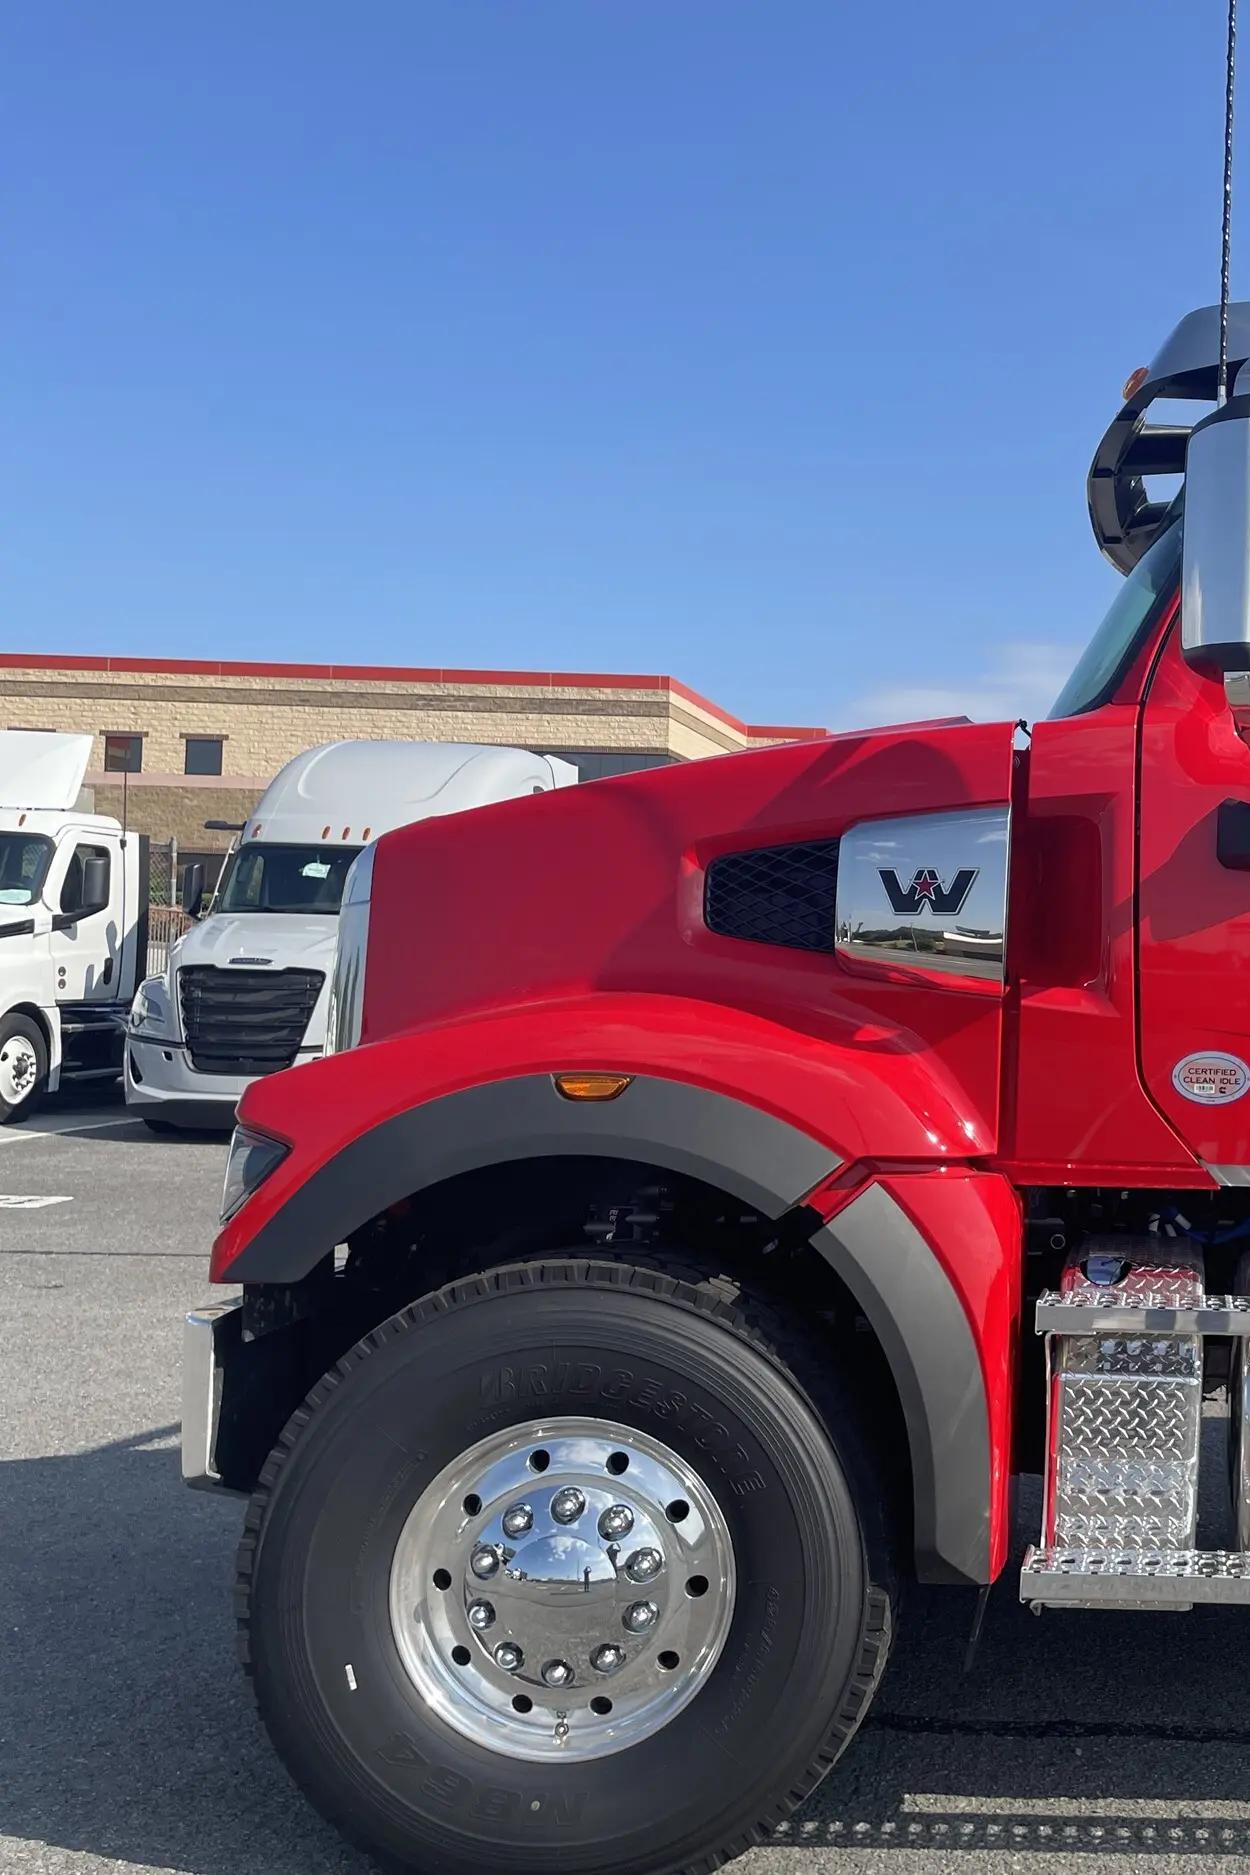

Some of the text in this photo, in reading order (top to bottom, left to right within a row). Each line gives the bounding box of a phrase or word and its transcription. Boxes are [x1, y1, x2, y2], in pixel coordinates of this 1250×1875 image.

[1188, 1067, 1237, 1077] CERTIFIED
[1183, 1076, 1241, 1085] CLEAN IDLE
